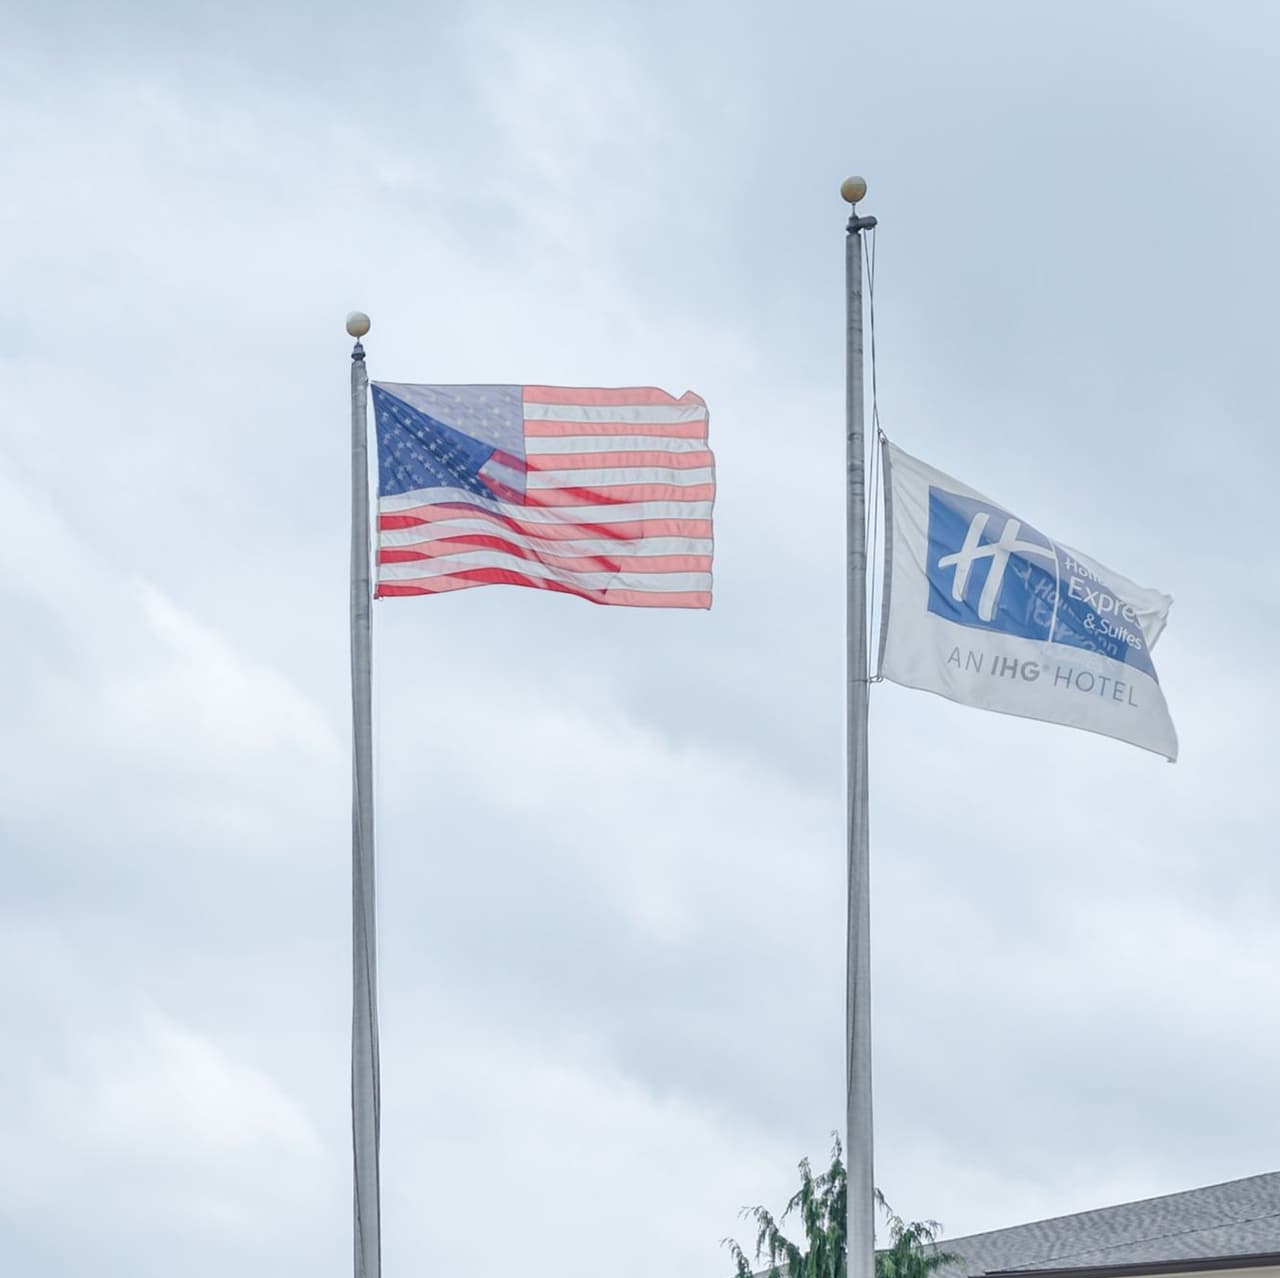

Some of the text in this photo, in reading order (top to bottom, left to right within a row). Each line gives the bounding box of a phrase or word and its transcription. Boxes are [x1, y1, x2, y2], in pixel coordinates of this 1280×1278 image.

[1083, 613, 1142, 650] & Suites
[947, 646, 984, 673] AN
[1053, 665, 1139, 708] HOTEL
